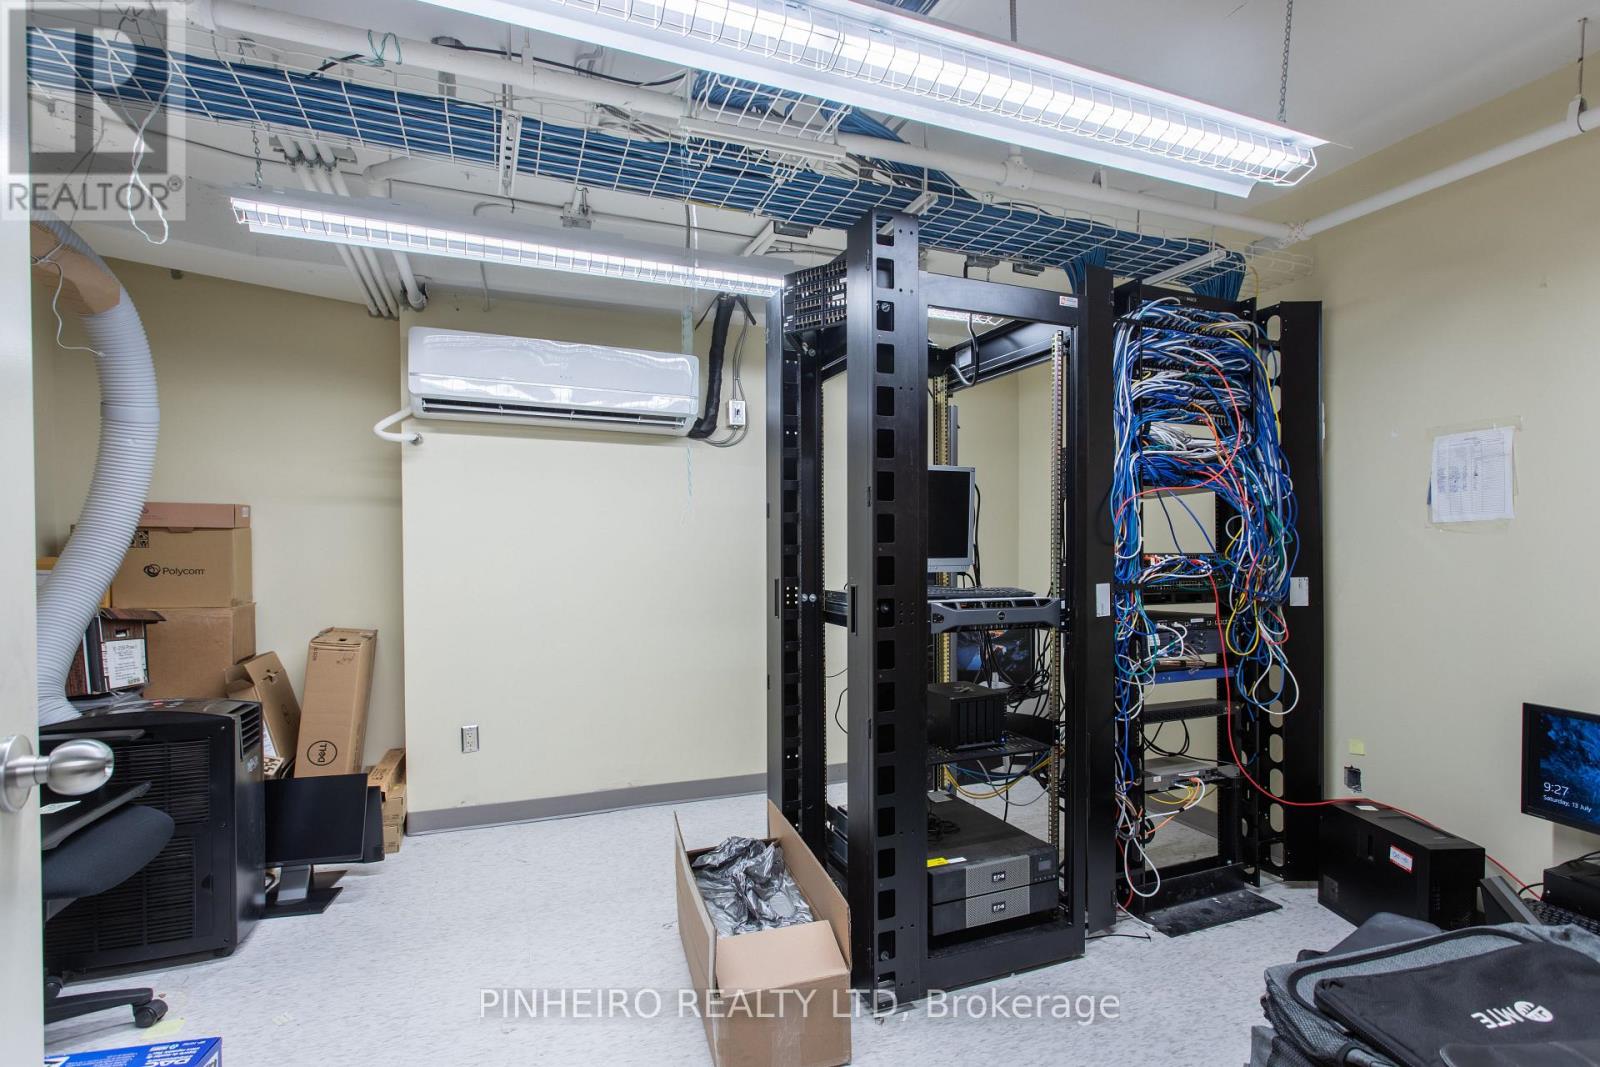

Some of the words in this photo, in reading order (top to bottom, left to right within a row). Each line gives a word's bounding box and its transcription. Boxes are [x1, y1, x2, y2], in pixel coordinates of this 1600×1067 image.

[162, 567, 205, 576] Polycom
[317, 743, 328, 763] DELL
[1543, 781, 1569, 797] 9:27
[1542, 794, 1570, 807] Saturday,
[1579, 804, 1593, 813] July
